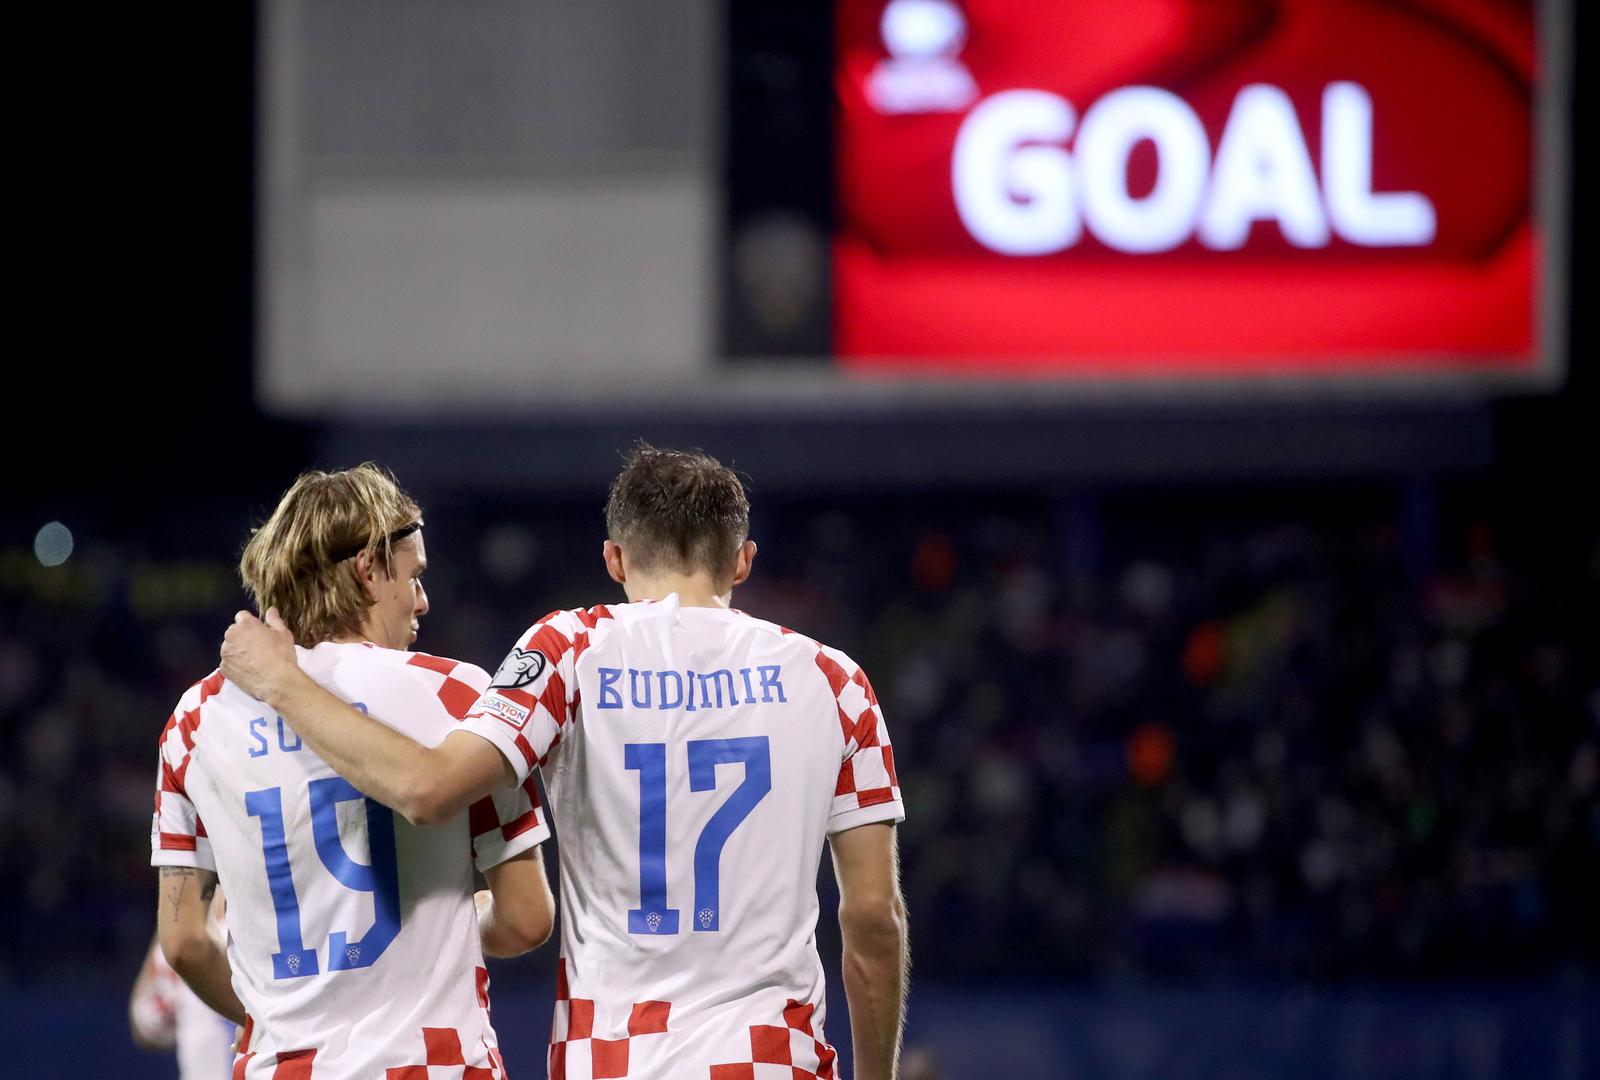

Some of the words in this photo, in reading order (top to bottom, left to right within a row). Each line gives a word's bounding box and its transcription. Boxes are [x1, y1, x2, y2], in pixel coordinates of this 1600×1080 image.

[952, 81, 1437, 255] GOAL
[597, 665, 788, 712] BUDIMIR
[244, 776, 401, 980] 19
[624, 736, 772, 935] 17
